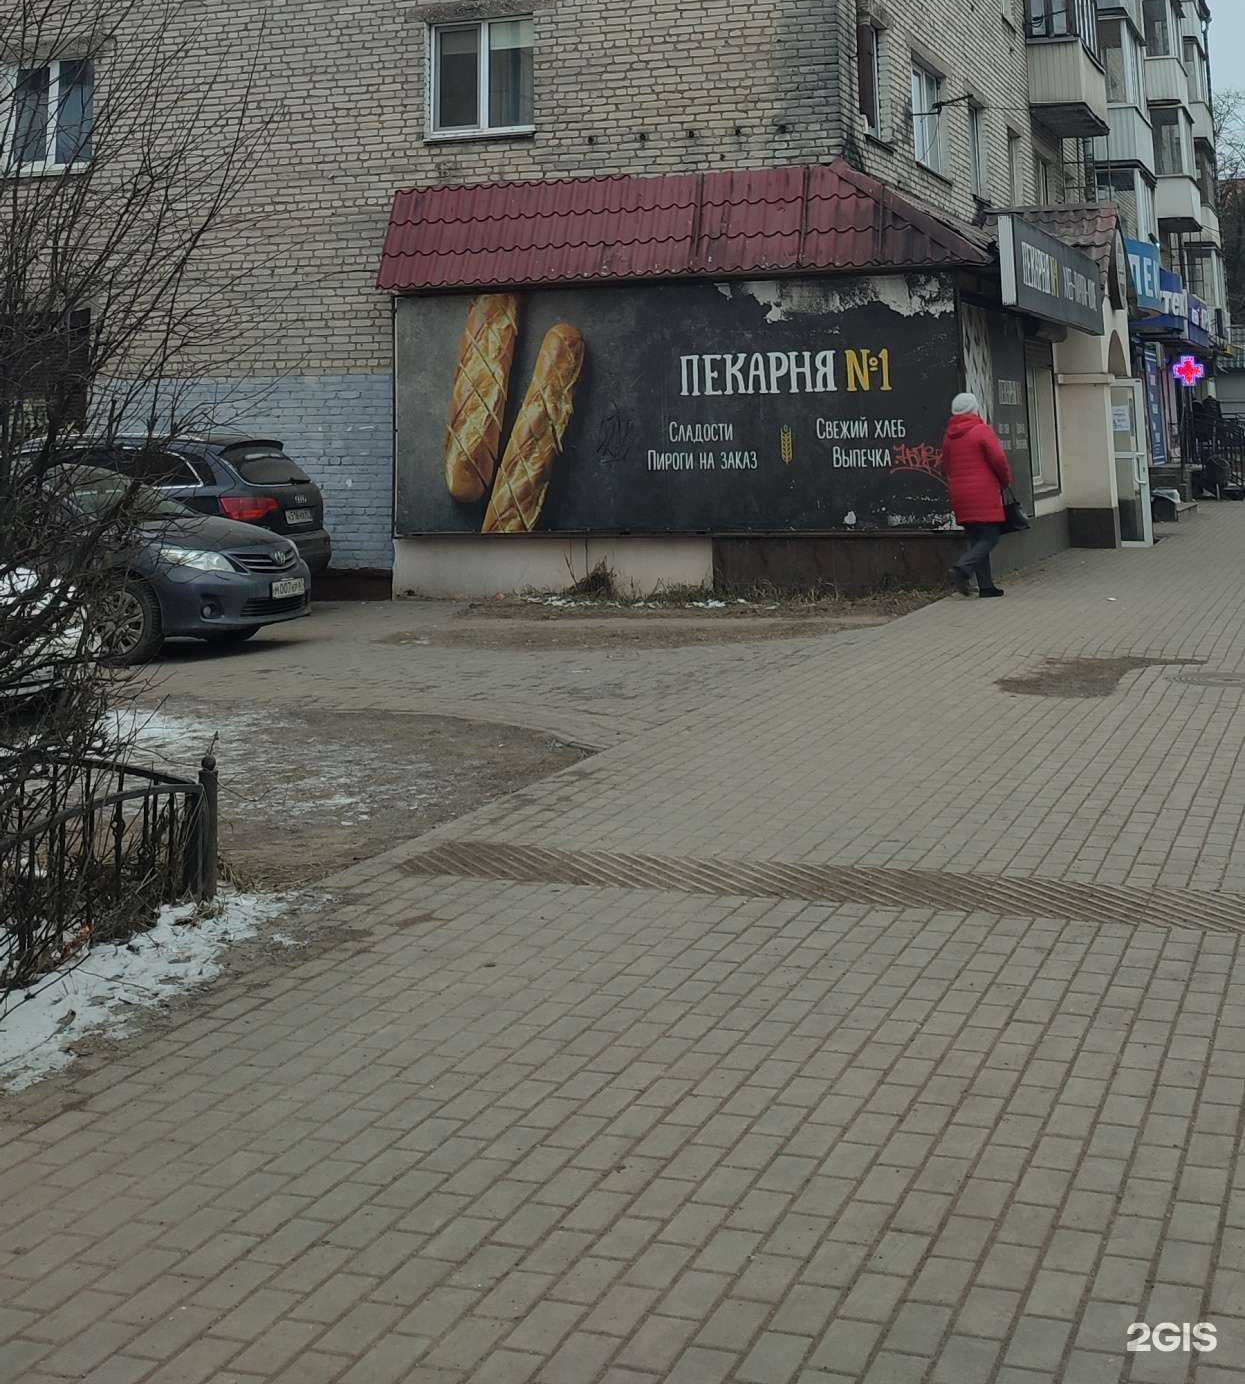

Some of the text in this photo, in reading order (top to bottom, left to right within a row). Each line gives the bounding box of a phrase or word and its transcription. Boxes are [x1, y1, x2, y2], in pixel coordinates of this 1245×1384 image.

[680, 348, 893, 396] ПЕКАРНЯ №1
[700, 450, 716, 470] НА
[720, 450, 759, 470] ЗАКАЗ
